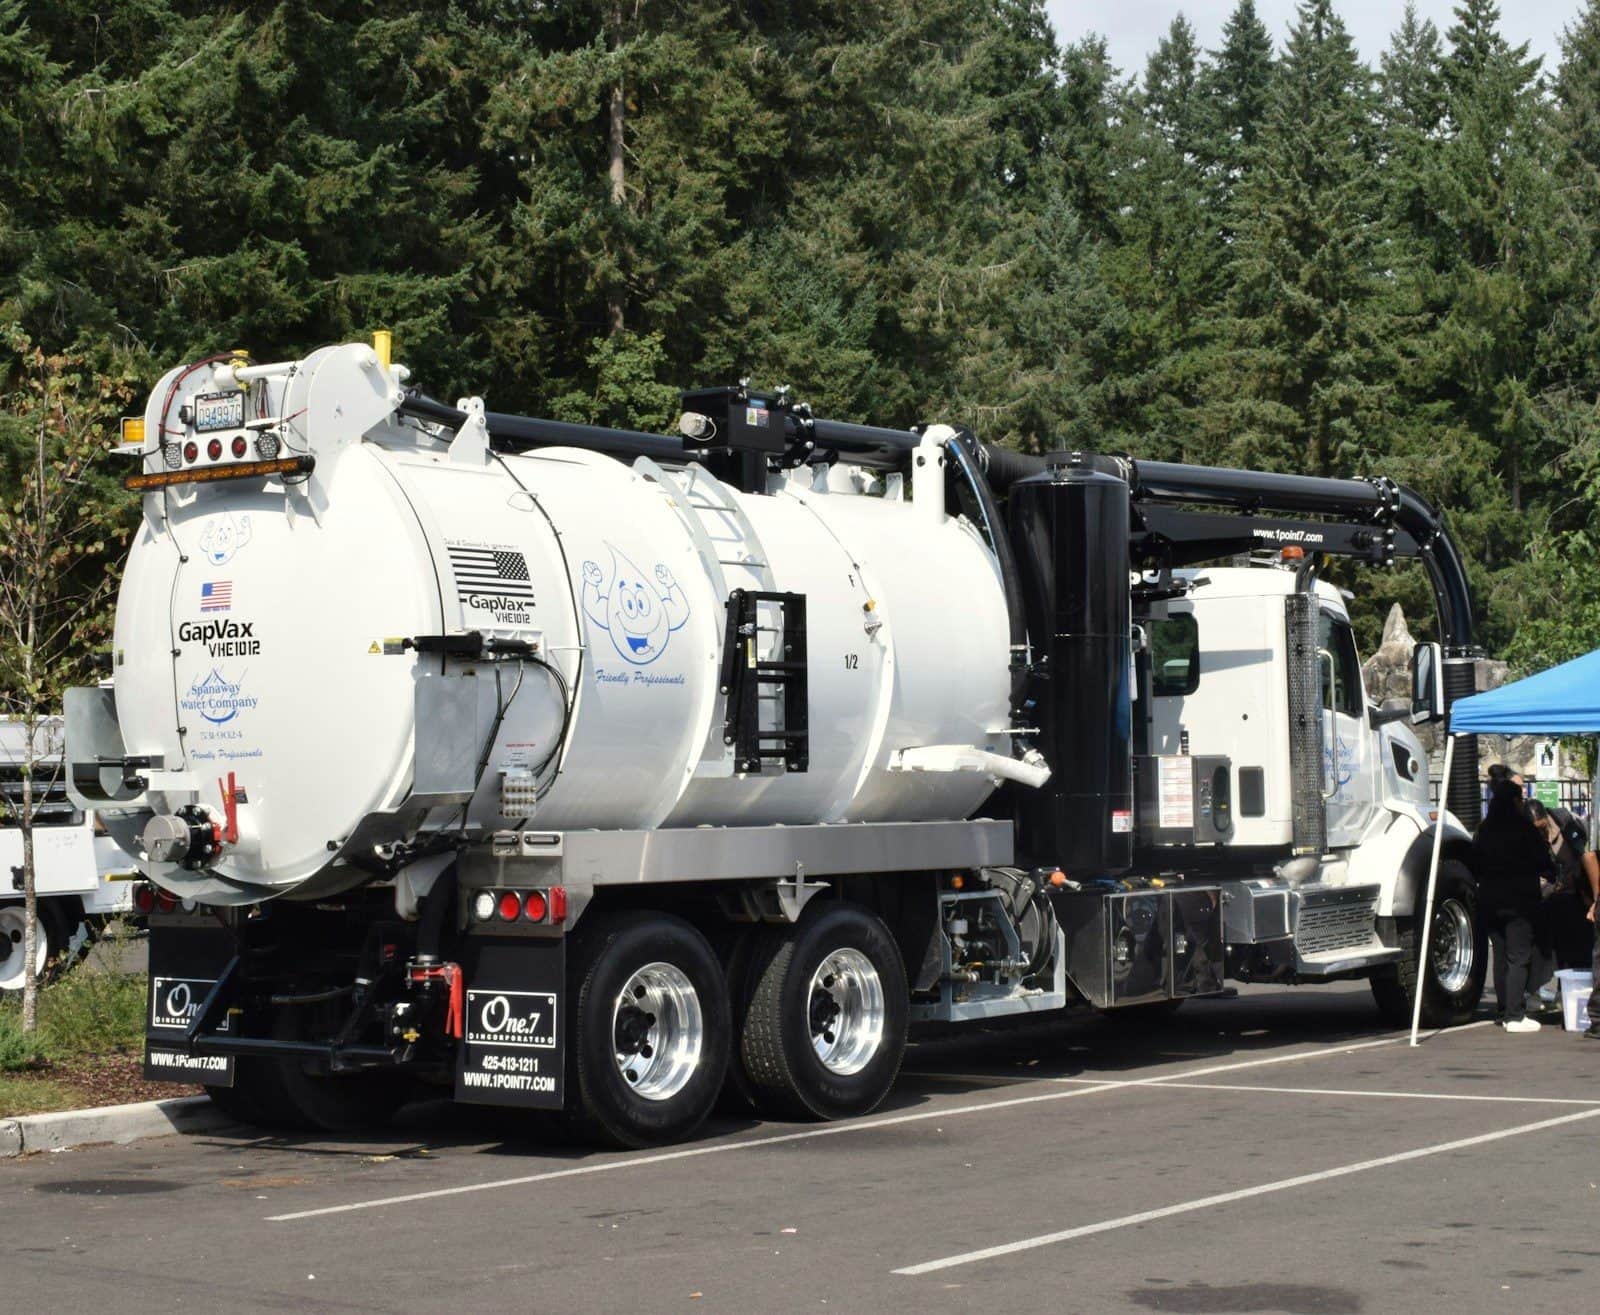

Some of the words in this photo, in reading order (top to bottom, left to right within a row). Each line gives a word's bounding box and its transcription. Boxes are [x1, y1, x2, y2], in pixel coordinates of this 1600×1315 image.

[1253, 528, 1323, 543] www.1point7.com
[469, 594, 525, 613] GapVax
[495, 612, 531, 624] VHE1012
[179, 619, 254, 646] GapVax
[208, 640, 261, 658] VHE1012
[844, 653, 858, 670] 1/2
[595, 669, 629, 684] Friendly
[633, 670, 685, 687] Professionals
[191, 683, 241, 698] Spanaway
[181, 699, 206, 710] Water
[208, 697, 258, 710] Company
[481, 995, 541, 1034] One.7
[475, 1033, 546, 1044] INCORPORATED
[482, 1055, 539, 1073] 425-413-1211
[463, 1072, 556, 1092] WWW.1POINT7.COM
